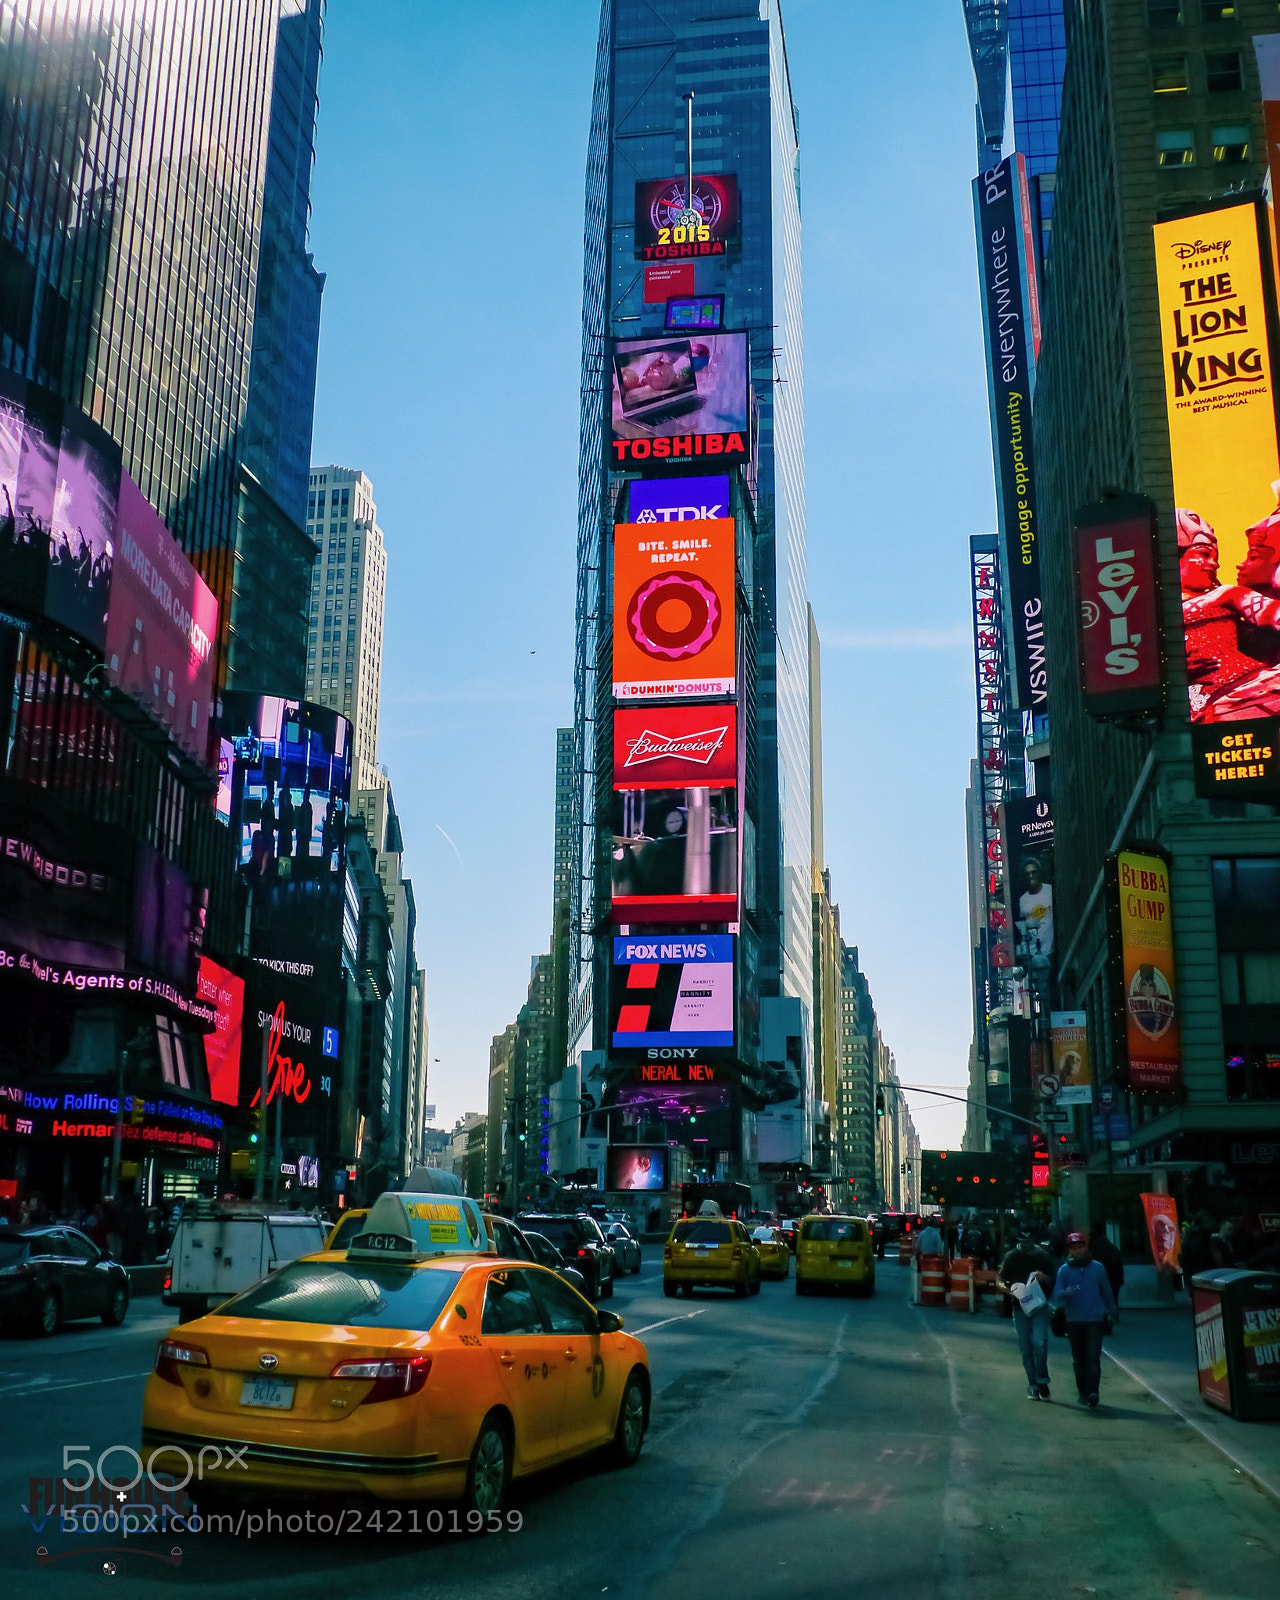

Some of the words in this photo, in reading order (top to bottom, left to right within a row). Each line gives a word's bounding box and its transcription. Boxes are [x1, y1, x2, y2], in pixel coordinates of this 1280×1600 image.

[657, 224, 710, 245] 2015
[644, 241, 724, 260] TOSHIBA
[1171, 239, 1232, 260] Disney
[1182, 255, 1230, 271] PRESENTS
[1179, 272, 1232, 302] THE
[991, 226, 1019, 383] everywhere
[1173, 305, 1247, 348] LION
[1171, 347, 1263, 398] KING
[1175, 401, 1192, 409] THE
[1193, 387, 1268, 406] AWARD-WINNING
[1192, 405, 1211, 414] BEST
[1212, 398, 1249, 411] MUSICAL
[612, 433, 745, 460] TOSHIBA
[1007, 391, 1029, 496] opportunity
[1014, 499, 1033, 565] engage
[638, 541, 669, 552] BITE.
[672, 538, 712, 550] SMILE.
[651, 552, 699, 563] REPEAT.
[121, 527, 150, 587] MORE
[150, 567, 172, 617] DATA
[173, 597, 212, 663] CAPACITY
[626, 738, 723, 755] Budweiser
[1221, 733, 1254, 748] GET
[1205, 747, 1273, 765] TICKETS
[1215, 764, 1265, 781] HERE!
[1121, 863, 1167, 893] BUBBA
[1127, 894, 1165, 921] GUMP
[626, 944, 658, 960] FOX
[660, 943, 707, 959] NEWS
[285, 961, 299, 975] THIS
[62, 970, 125, 991] Agents
[128, 976, 144, 991] of
[292, 1023, 312, 1045] YOUR
[648, 1048, 699, 1059] SONY
[1130, 1060, 1178, 1072] RESTAURANT
[1139, 1073, 1171, 1083] MARKET
[24, 1091, 60, 1110] How
[64, 1093, 120, 1114] Rolling
